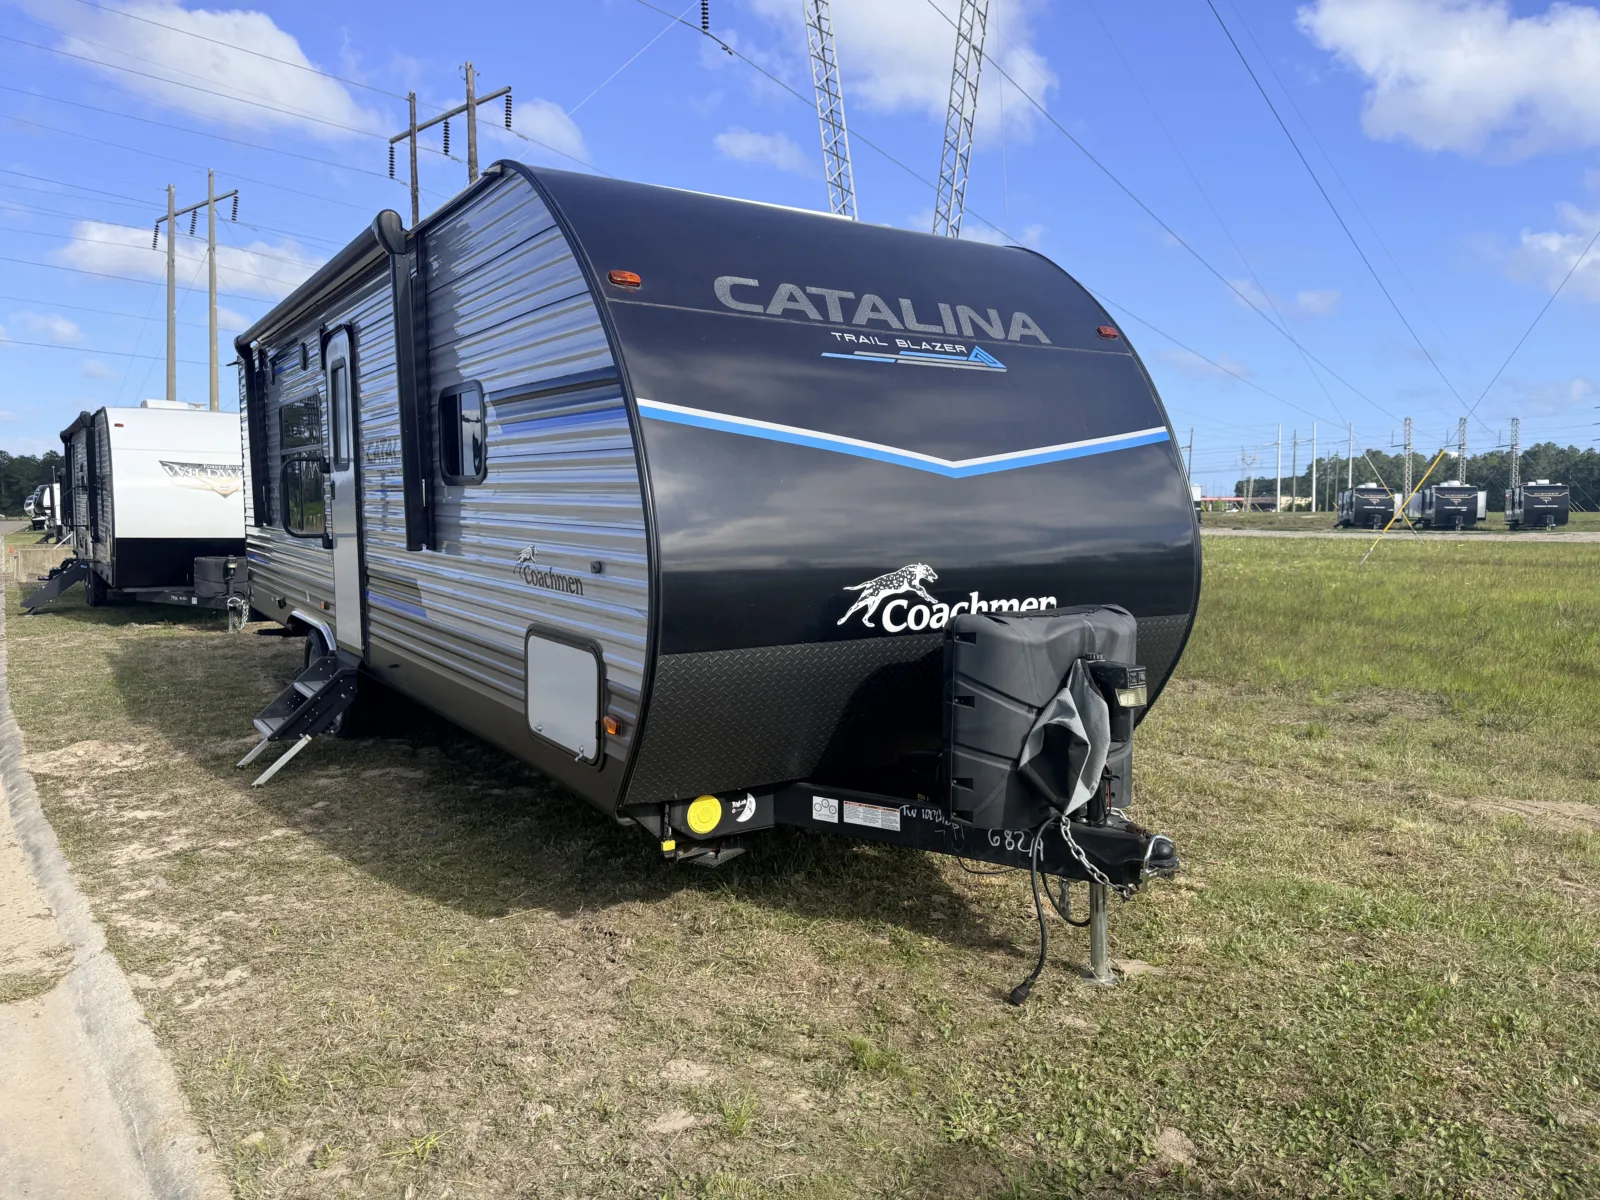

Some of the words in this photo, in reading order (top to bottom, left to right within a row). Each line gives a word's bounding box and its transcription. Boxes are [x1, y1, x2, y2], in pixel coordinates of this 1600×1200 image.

[713, 275, 1052, 344] CATALINA
[830, 331, 888, 346] TRAIL
[895, 338, 968, 354] BLAZER
[523, 564, 584, 596] Coachmen
